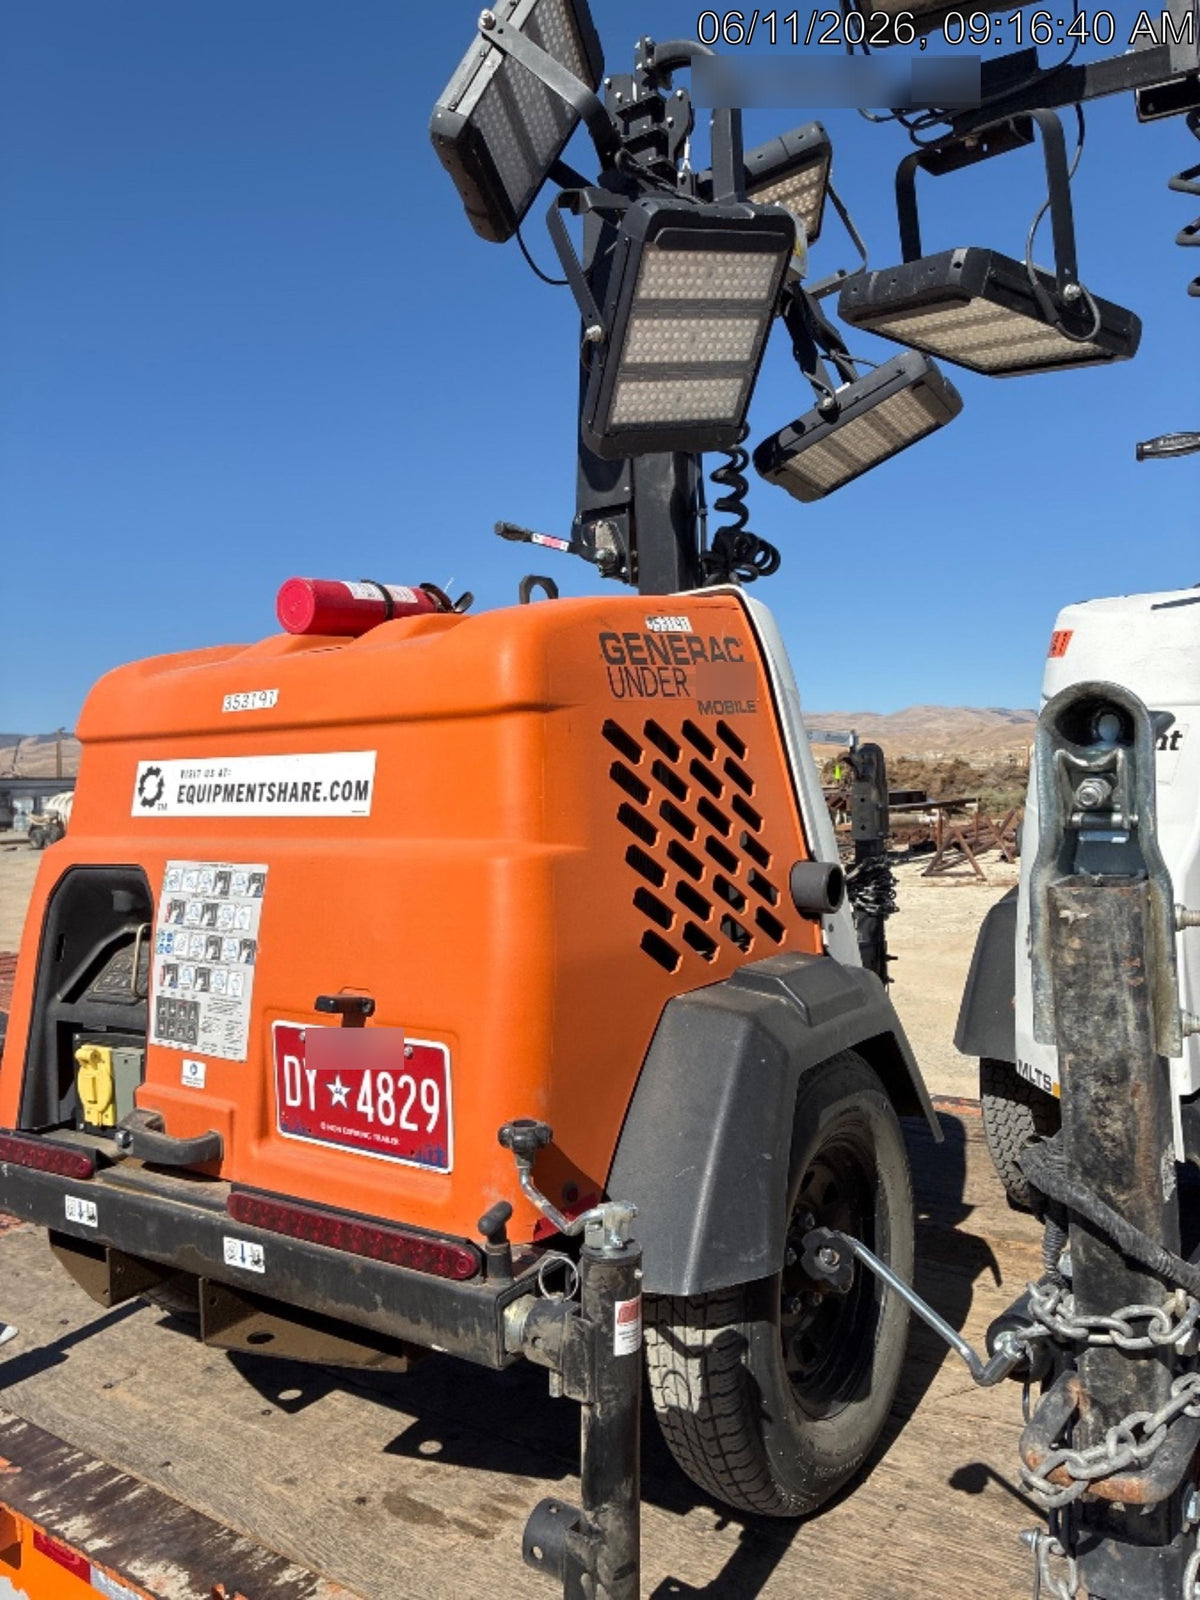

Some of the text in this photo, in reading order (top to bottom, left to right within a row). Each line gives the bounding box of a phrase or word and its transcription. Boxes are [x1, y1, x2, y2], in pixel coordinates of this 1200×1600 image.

[599, 632, 744, 665] GENERAC
[607, 666, 690, 699] UNDER
[697, 700, 757, 715] MOBILE
[176, 779, 370, 805] EQUIPMENTSHARE.COM
[284, 1055, 441, 1134] DY 4829
